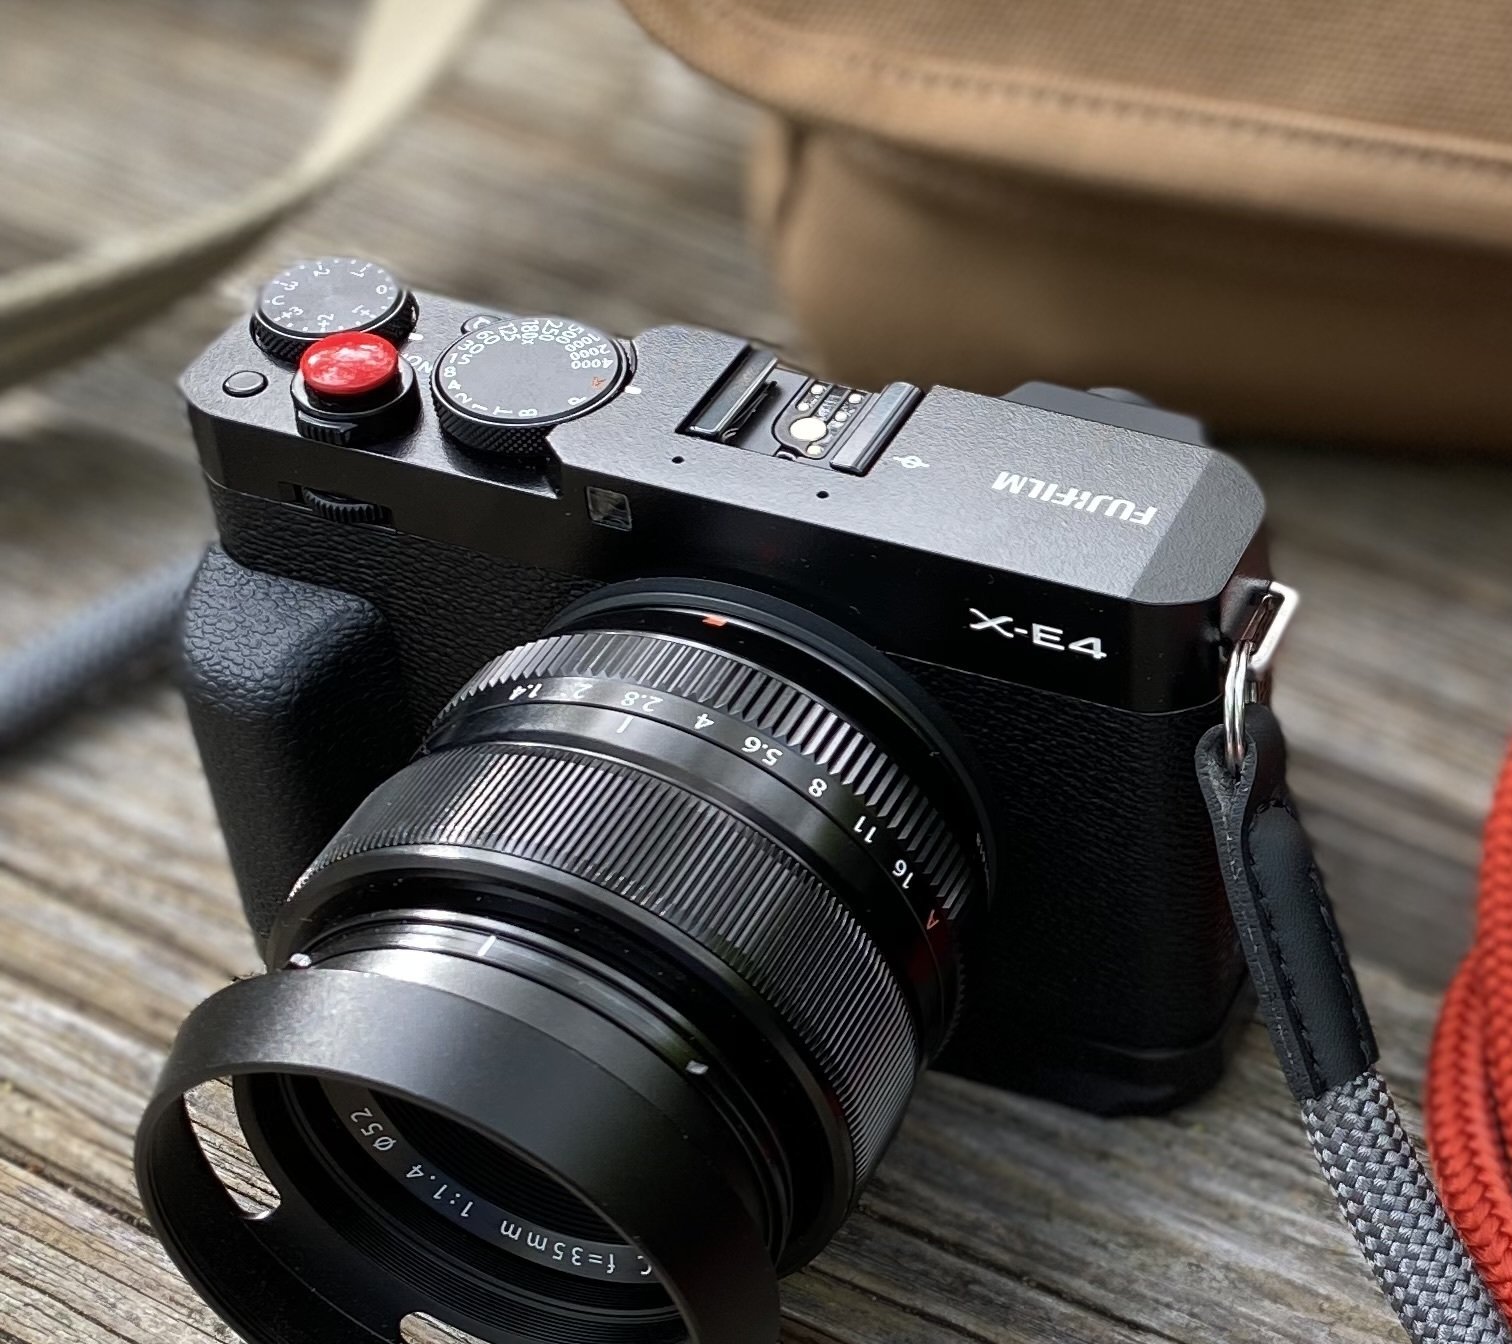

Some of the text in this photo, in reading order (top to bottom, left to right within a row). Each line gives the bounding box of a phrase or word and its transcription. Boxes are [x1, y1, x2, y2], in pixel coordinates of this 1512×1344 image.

[271, 295, 285, 305] C
[476, 330, 501, 345] 60
[498, 322, 521, 342] 125
[539, 319, 563, 342] 250
[555, 323, 584, 344] 500
[457, 339, 485, 354] 30
[570, 344, 611, 360] 2000
[449, 353, 473, 365] 15
[571, 358, 614, 369] 4000
[443, 366, 457, 378] 8
[448, 379, 462, 390] 4
[454, 392, 472, 404] 2
[493, 406, 513, 416] T
[992, 471, 1158, 527] FUJIFILM
[969, 607, 1107, 660] X-E4
[621, 691, 663, 712] 2.8
[694, 713, 714, 730] 4
[741, 736, 784, 767] 5.6
[807, 778, 828, 798] 8
[853, 816, 877, 844] 11
[892, 859, 914, 889] 16
[405, 1163, 475, 1219] 1:1.4
[500, 1220, 617, 1274] f=35mm
